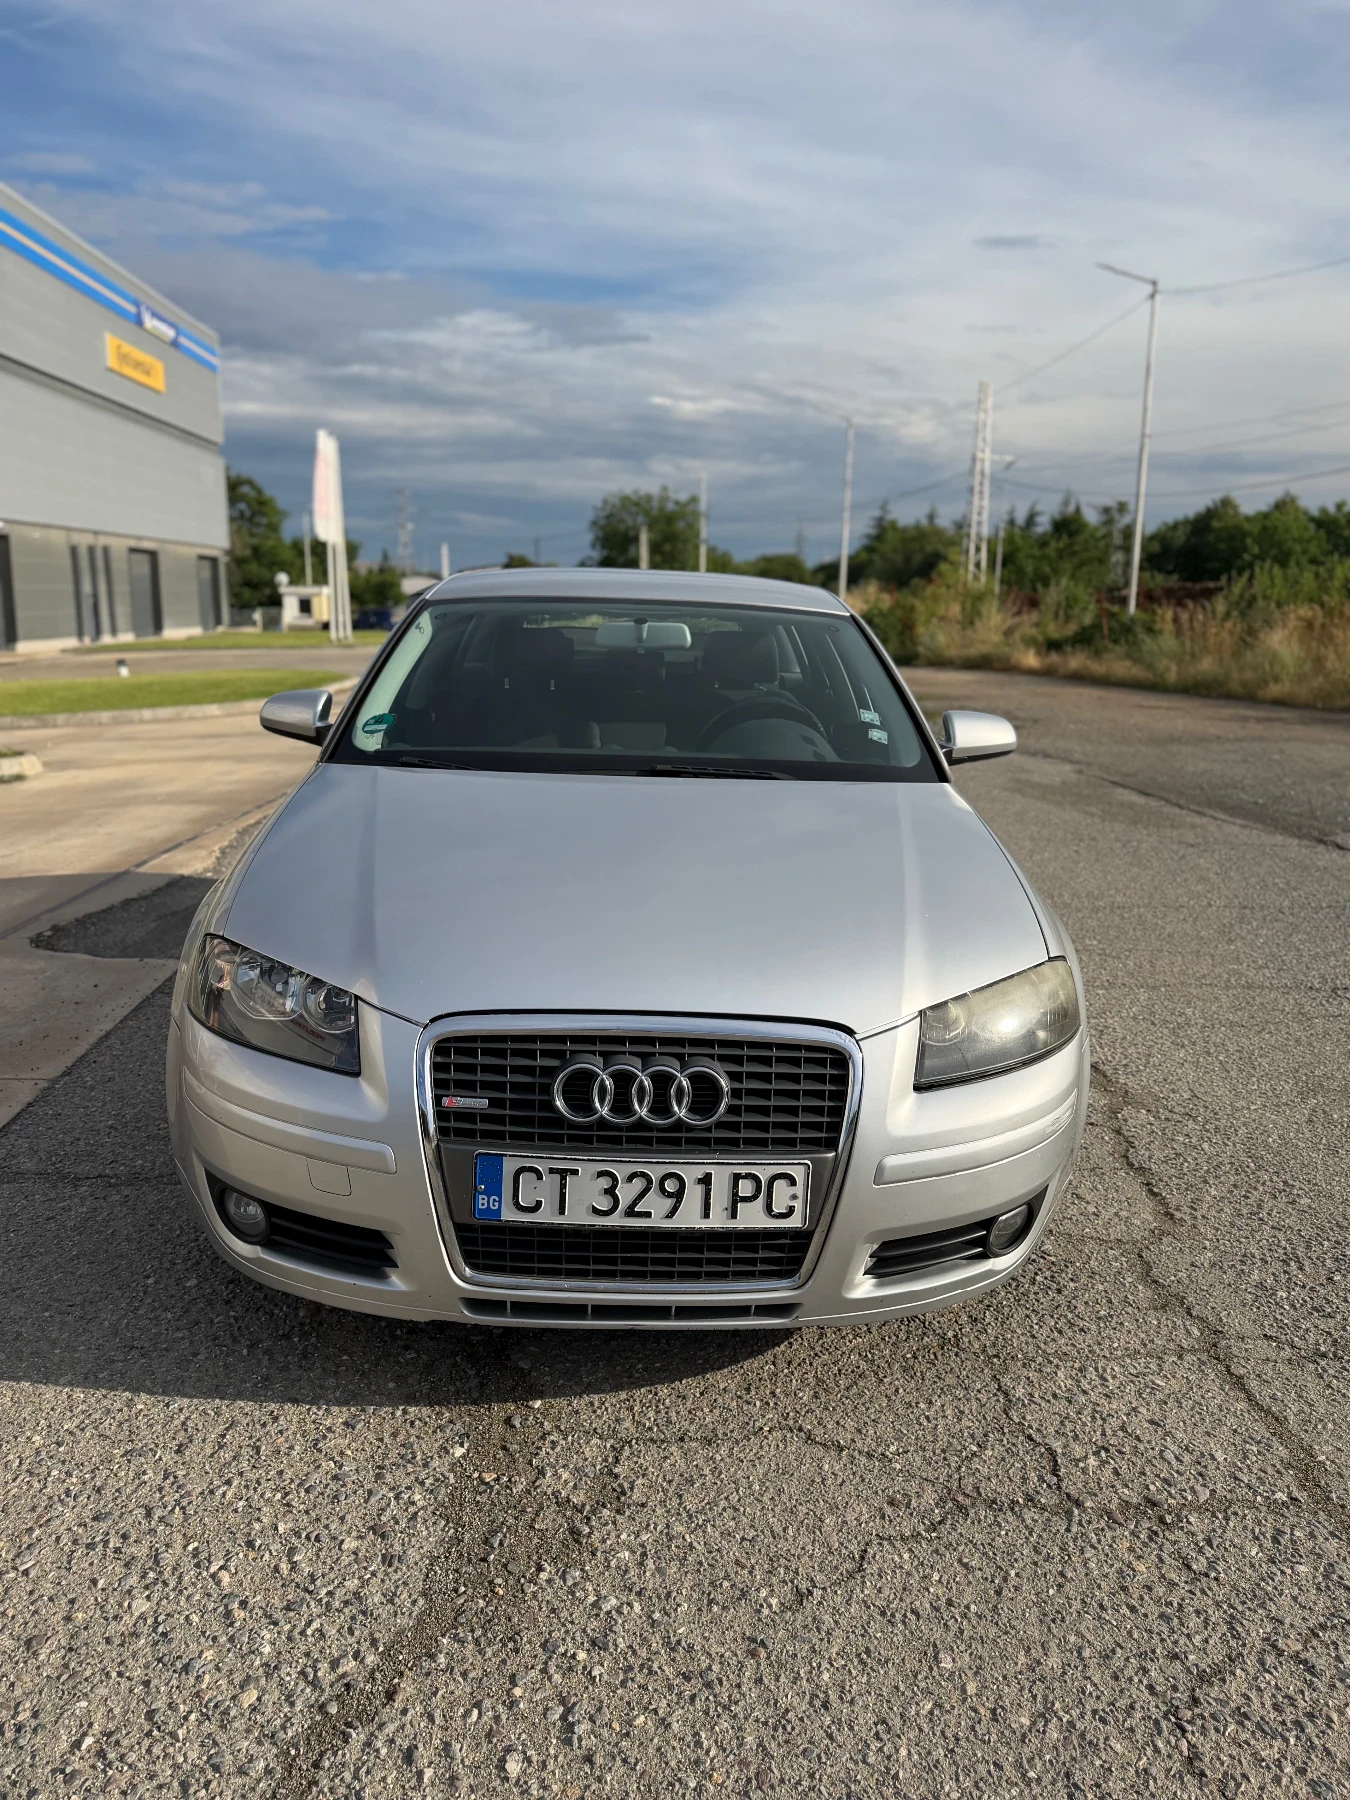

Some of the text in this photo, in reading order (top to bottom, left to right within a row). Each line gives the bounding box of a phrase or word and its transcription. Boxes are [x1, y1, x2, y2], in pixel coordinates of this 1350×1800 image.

[478, 1195, 499, 1210] BG
[512, 1164, 798, 1220] CT 3291 PC
